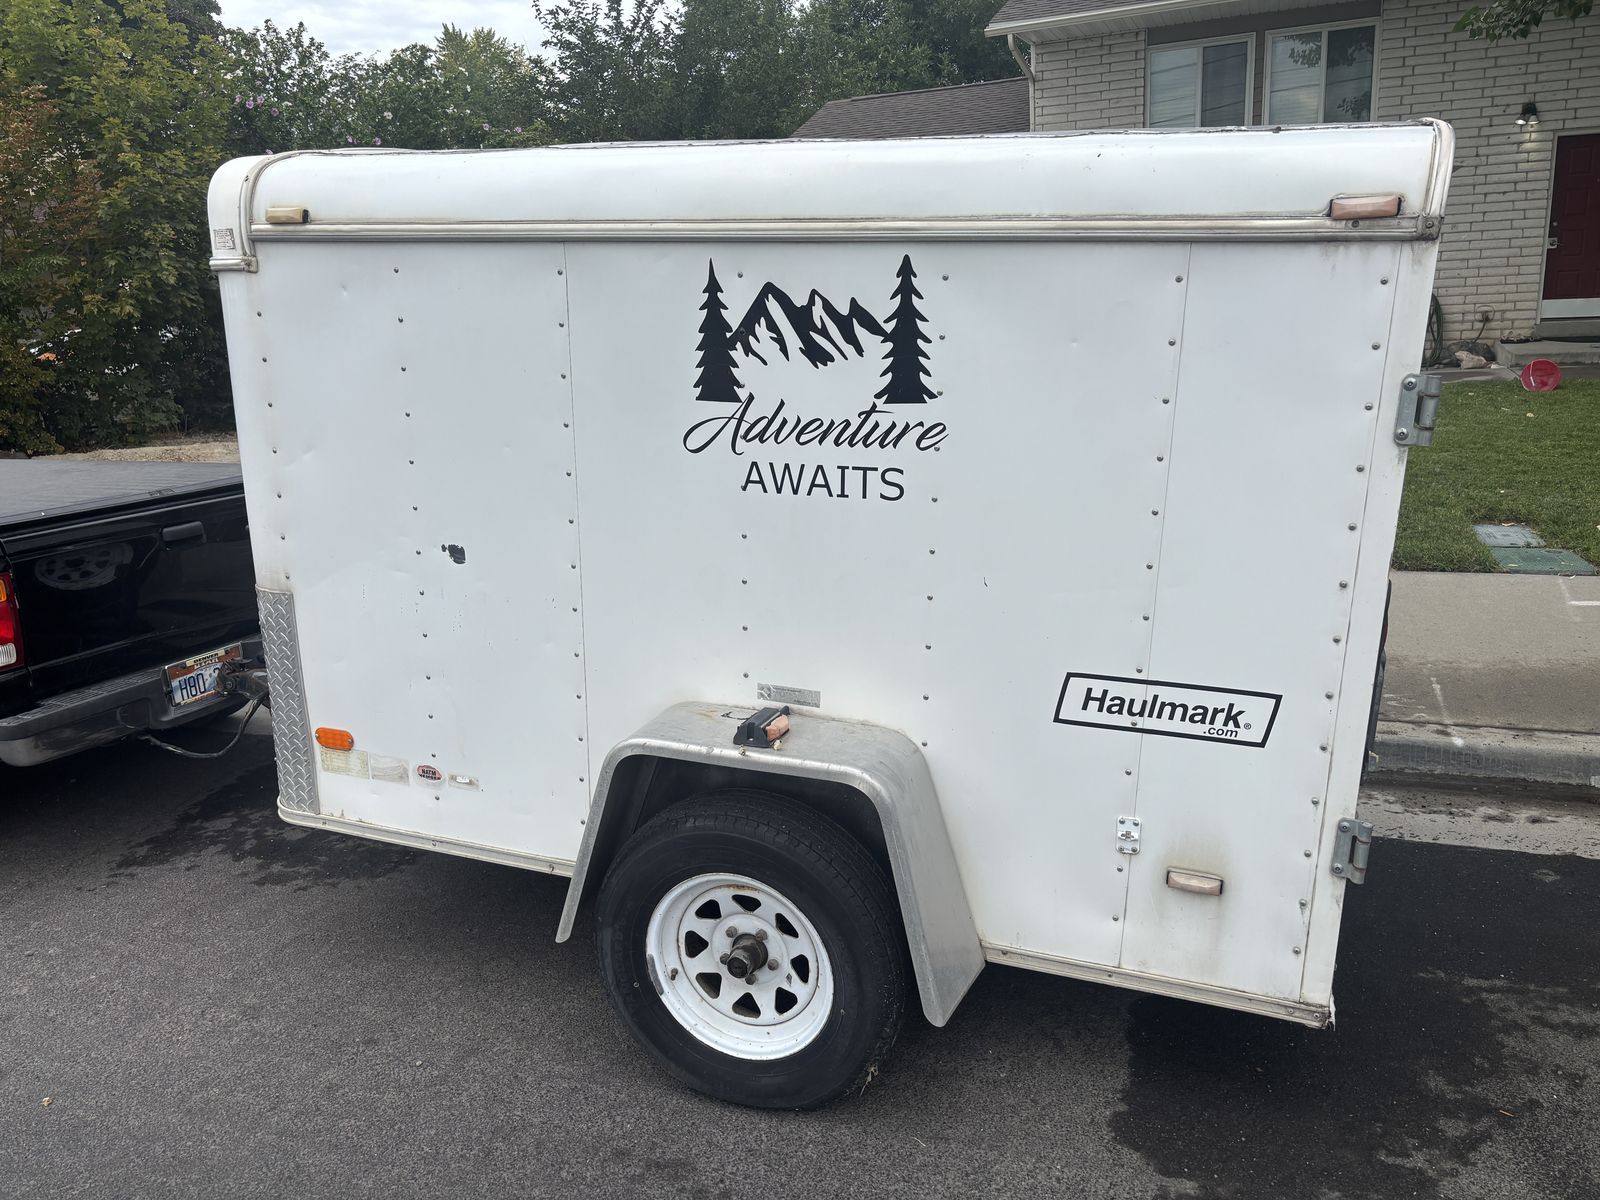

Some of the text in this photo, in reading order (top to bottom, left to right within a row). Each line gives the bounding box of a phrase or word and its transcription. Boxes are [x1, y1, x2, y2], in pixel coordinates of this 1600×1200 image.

[683, 391, 949, 455] Adventure
[742, 461, 905, 501] AWAITS
[1203, 727, 1239, 739] .com
